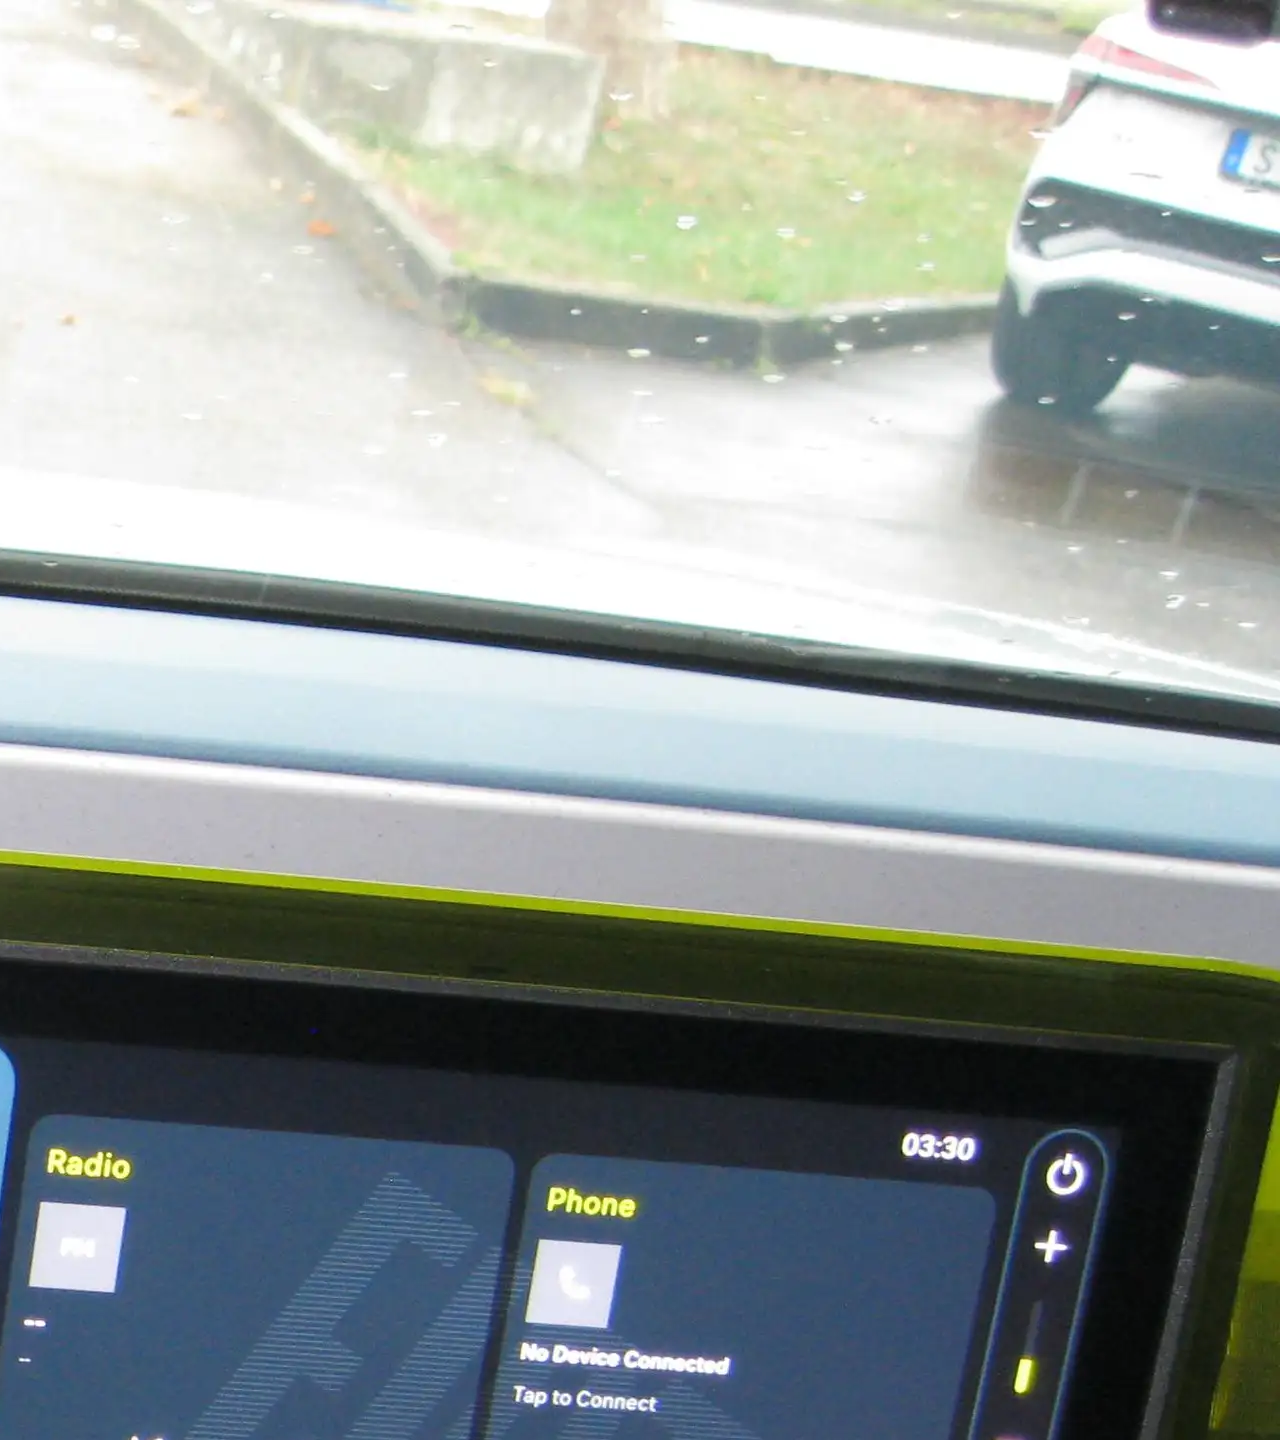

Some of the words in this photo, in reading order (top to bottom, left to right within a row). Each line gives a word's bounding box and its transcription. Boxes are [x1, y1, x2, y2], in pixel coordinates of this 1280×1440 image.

[902, 1132, 975, 1161] 03:30
[46, 1147, 132, 1181] Radio
[546, 1186, 637, 1219] Phone
[519, 1342, 550, 1363] No
[552, 1345, 621, 1367] Device
[623, 1350, 731, 1376] Connected
[513, 1385, 548, 1408] Tap
[552, 1389, 571, 1407] to
[576, 1390, 658, 1413] Connect
